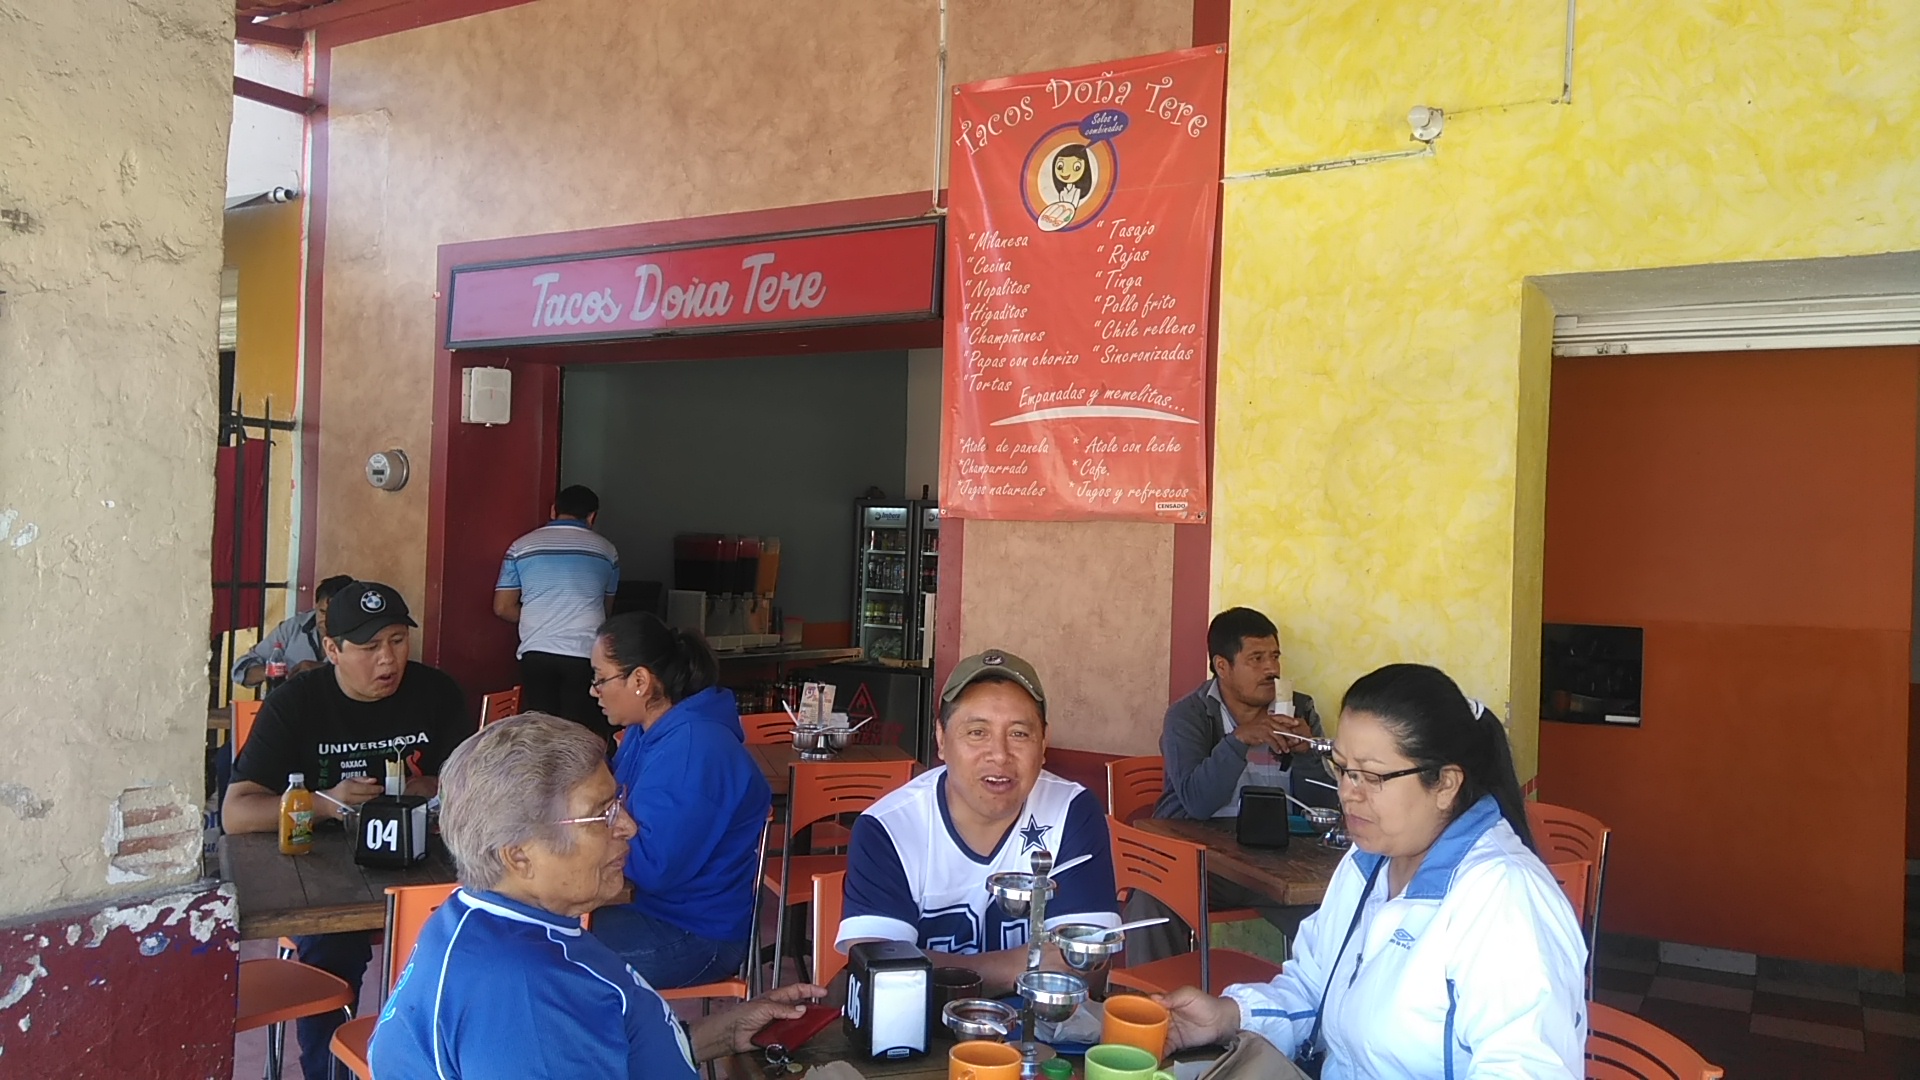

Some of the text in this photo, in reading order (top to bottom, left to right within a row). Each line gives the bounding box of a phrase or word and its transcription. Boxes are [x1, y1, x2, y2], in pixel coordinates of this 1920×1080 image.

[956, 71, 1208, 155] Tacos Doña Tere
[531, 252, 827, 328] Tacos Doña Tere
[1141, 292, 1176, 319] frito
[1142, 315, 1196, 336] relleno
[1009, 356, 1029, 368] con
[1032, 348, 1079, 366] chorizo
[1019, 382, 1086, 410] Empanadas
[1086, 389, 1099, 406] y
[960, 437, 1049, 459] Atole de panela
[1084, 436, 1182, 454] Atole con leche
[961, 458, 1028, 479] Champurrado
[960, 479, 1047, 501] Jugos naturales
[1077, 480, 1189, 504] Jugos y refrescos
[318, 731, 430, 755] UNIVERSIADA
[340, 760, 368, 769] OAXACA
[366, 818, 398, 851] 04
[847, 973, 862, 1029] 06
